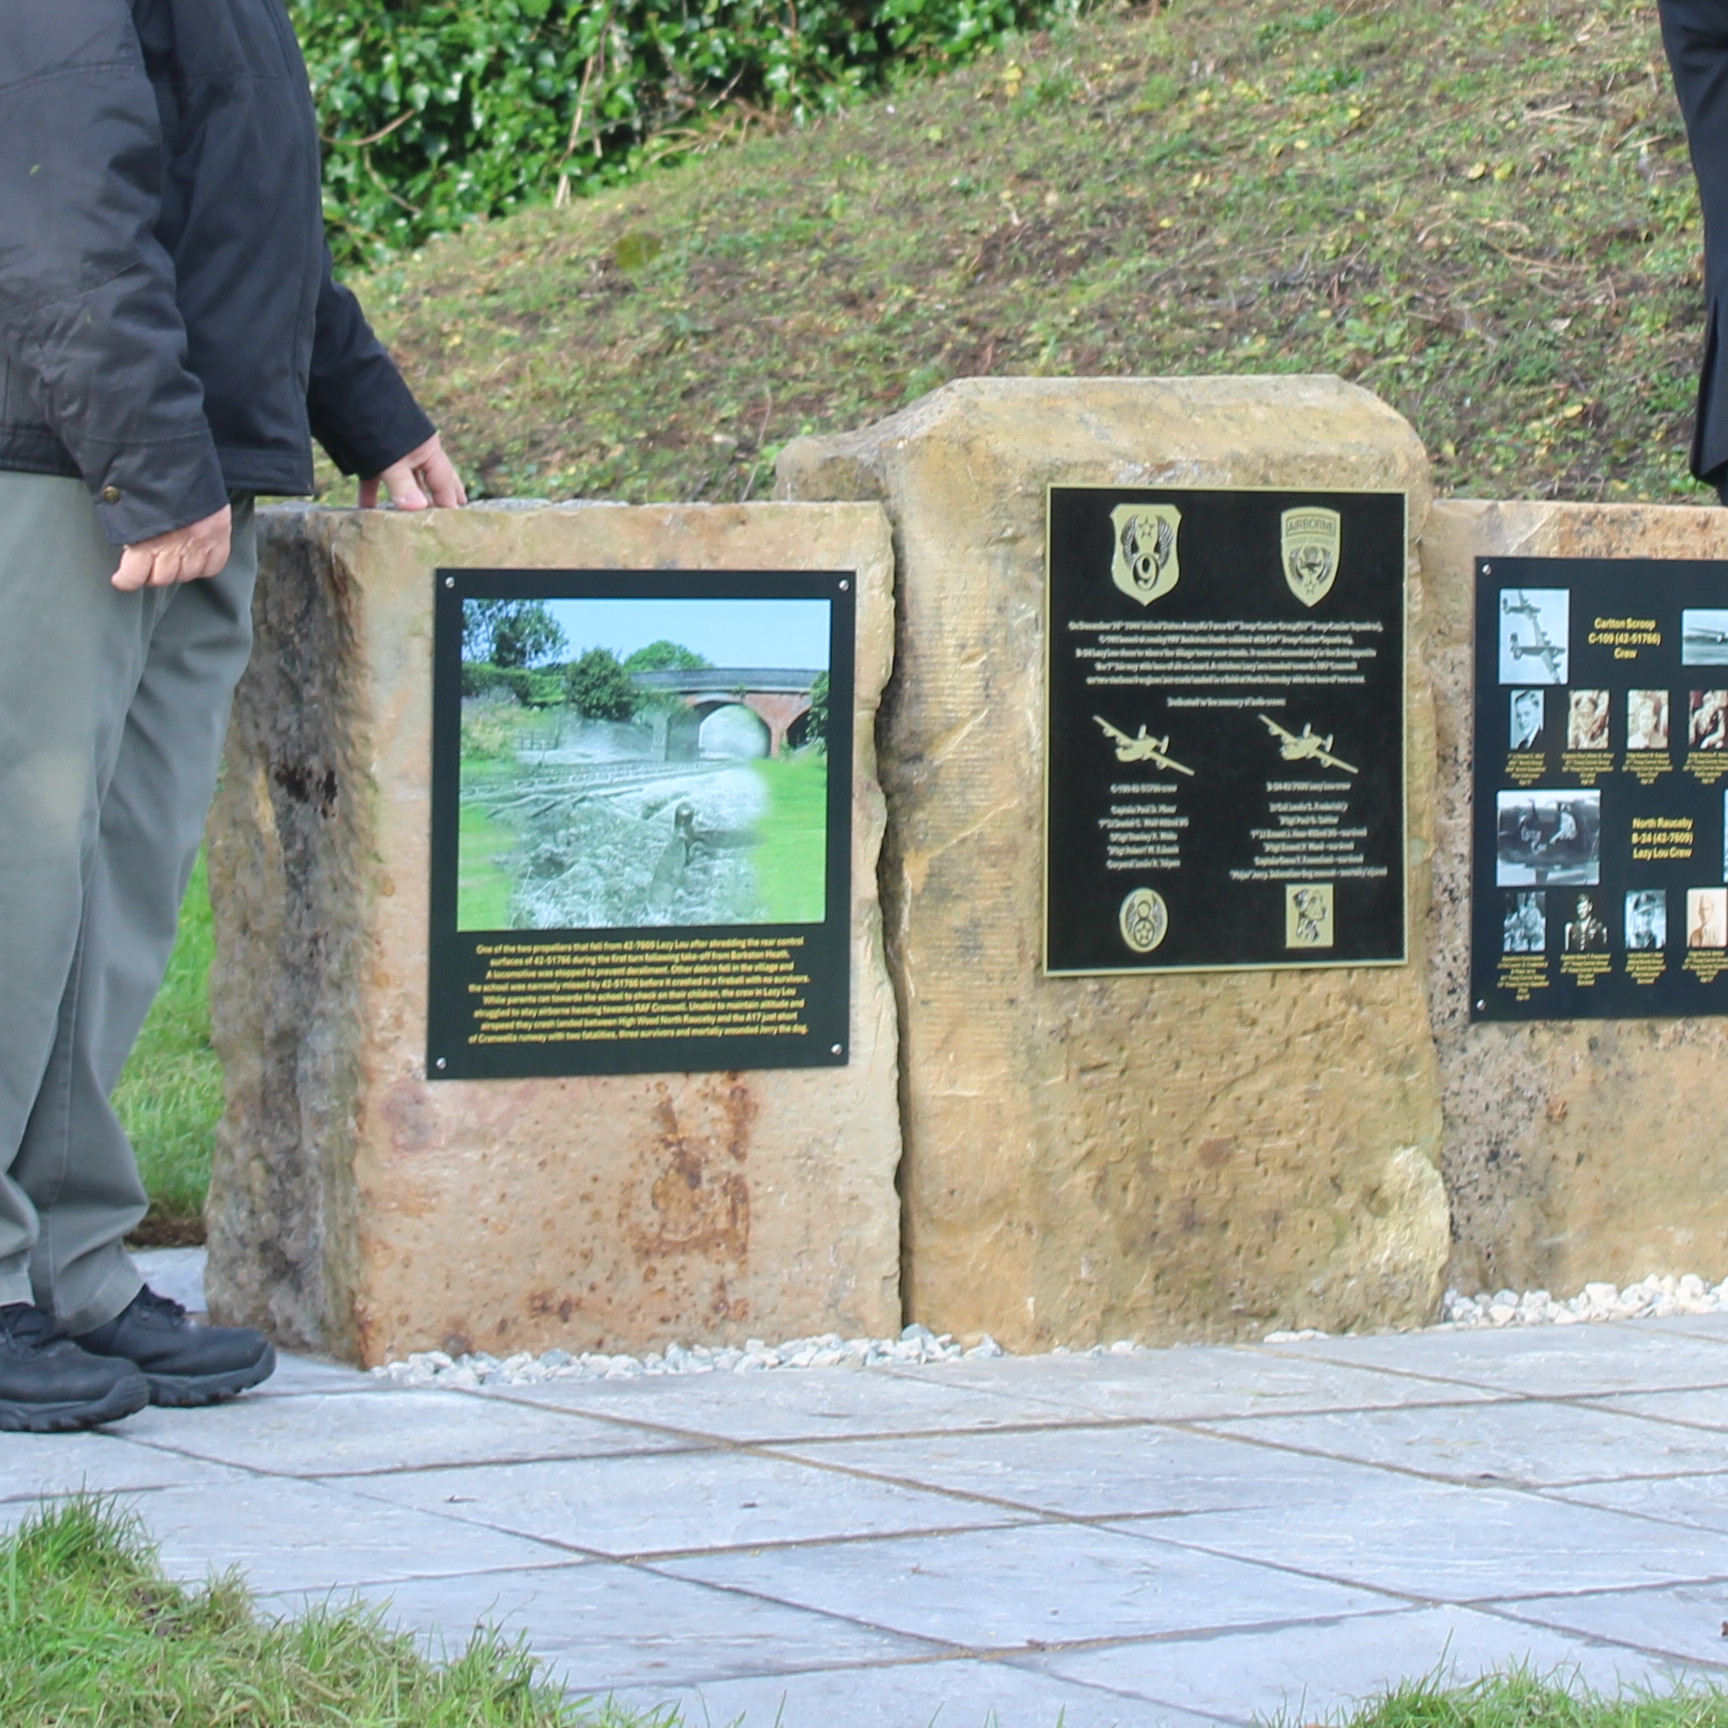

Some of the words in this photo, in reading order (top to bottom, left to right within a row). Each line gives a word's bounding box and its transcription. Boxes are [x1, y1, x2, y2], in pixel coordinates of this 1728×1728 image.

[1288, 519, 1334, 533] AIRBORNE
[1594, 617, 1626, 630] Carlton
[1627, 618, 1656, 631] Scroop
[1588, 632, 1614, 645] C-109
[1615, 632, 1661, 646] (42-51766)
[1614, 647, 1637, 659] Crew
[1632, 817, 1657, 829] North
[1657, 818, 1693, 830] Rauceby
[1631, 832, 1652, 845] B-24
[1653, 832, 1693, 845] (42-7609)
[1633, 847, 1652, 860] Lazy
[1654, 847, 1669, 859] Lou
[1669, 847, 1693, 859] Crew
